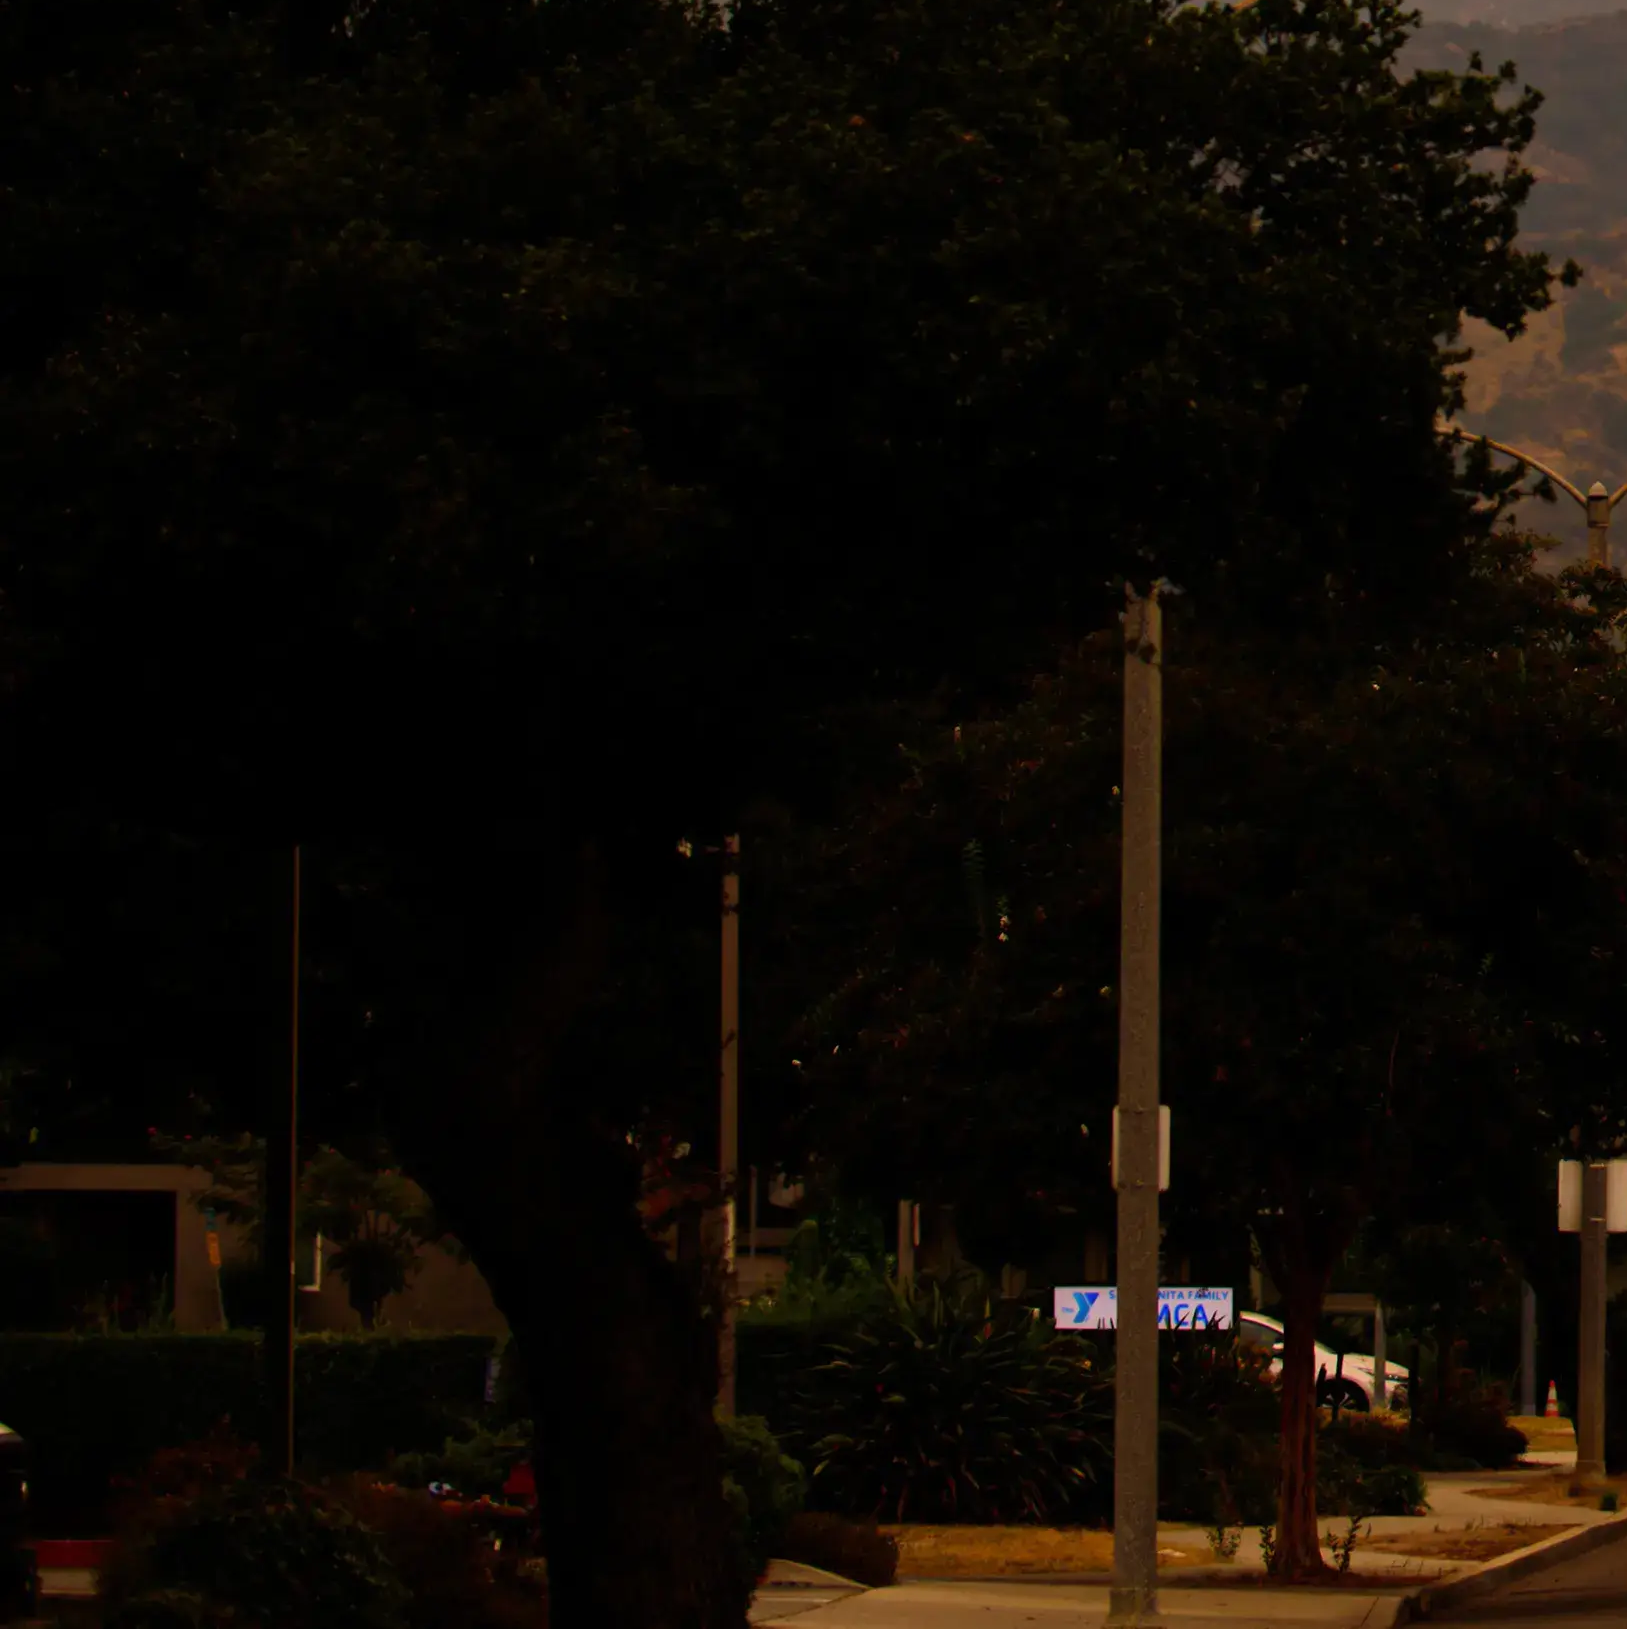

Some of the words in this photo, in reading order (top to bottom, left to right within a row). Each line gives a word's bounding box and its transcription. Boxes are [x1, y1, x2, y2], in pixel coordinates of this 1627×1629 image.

[1157, 1291, 1184, 1300] NITA
[1188, 1291, 1229, 1300] FAMILY
[1157, 1304, 1209, 1326] MCA
